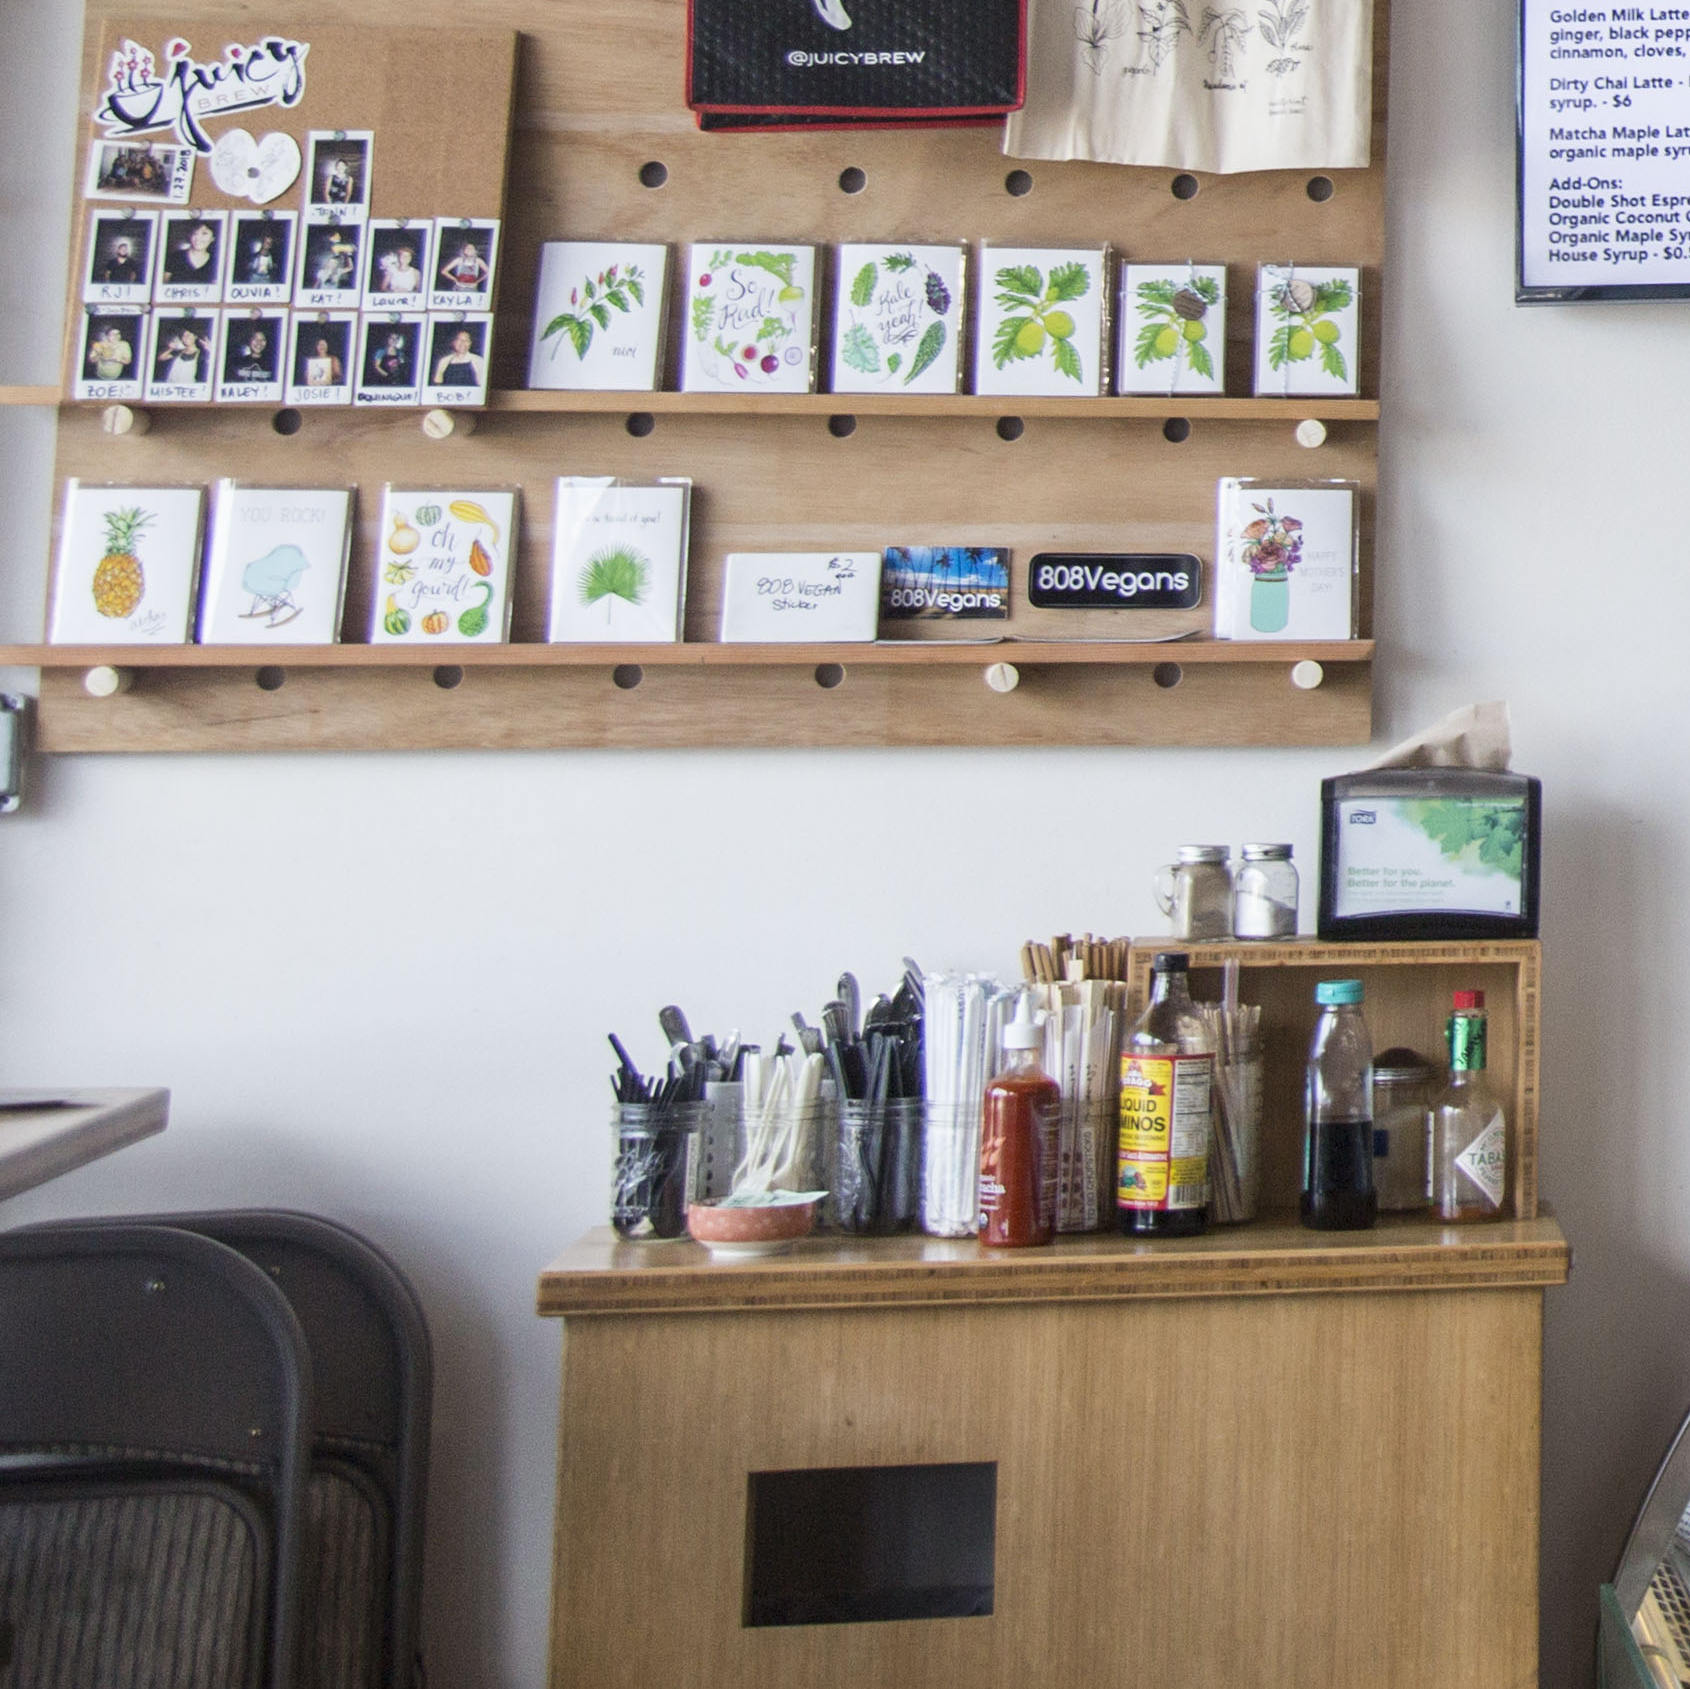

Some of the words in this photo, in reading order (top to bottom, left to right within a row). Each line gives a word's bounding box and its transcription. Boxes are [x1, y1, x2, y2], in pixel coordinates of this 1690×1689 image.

[787, 50, 925, 67] @JUICYBREW
[198, 85, 270, 109] BREW
[1549, 248, 1598, 262] House
[1603, 248, 1649, 265] Syrup
[757, 577, 795, 596] 808
[798, 578, 843, 597] VEGAN
[1038, 565, 1189, 597] 808Vegans
[891, 588, 1001, 612] 808Vegans
[1348, 866, 1380, 876] Better
[1384, 866, 1398, 876] for
[1348, 878, 1380, 888] Better
[1384, 878, 1398, 888] for
[1401, 878, 1417, 888] the
